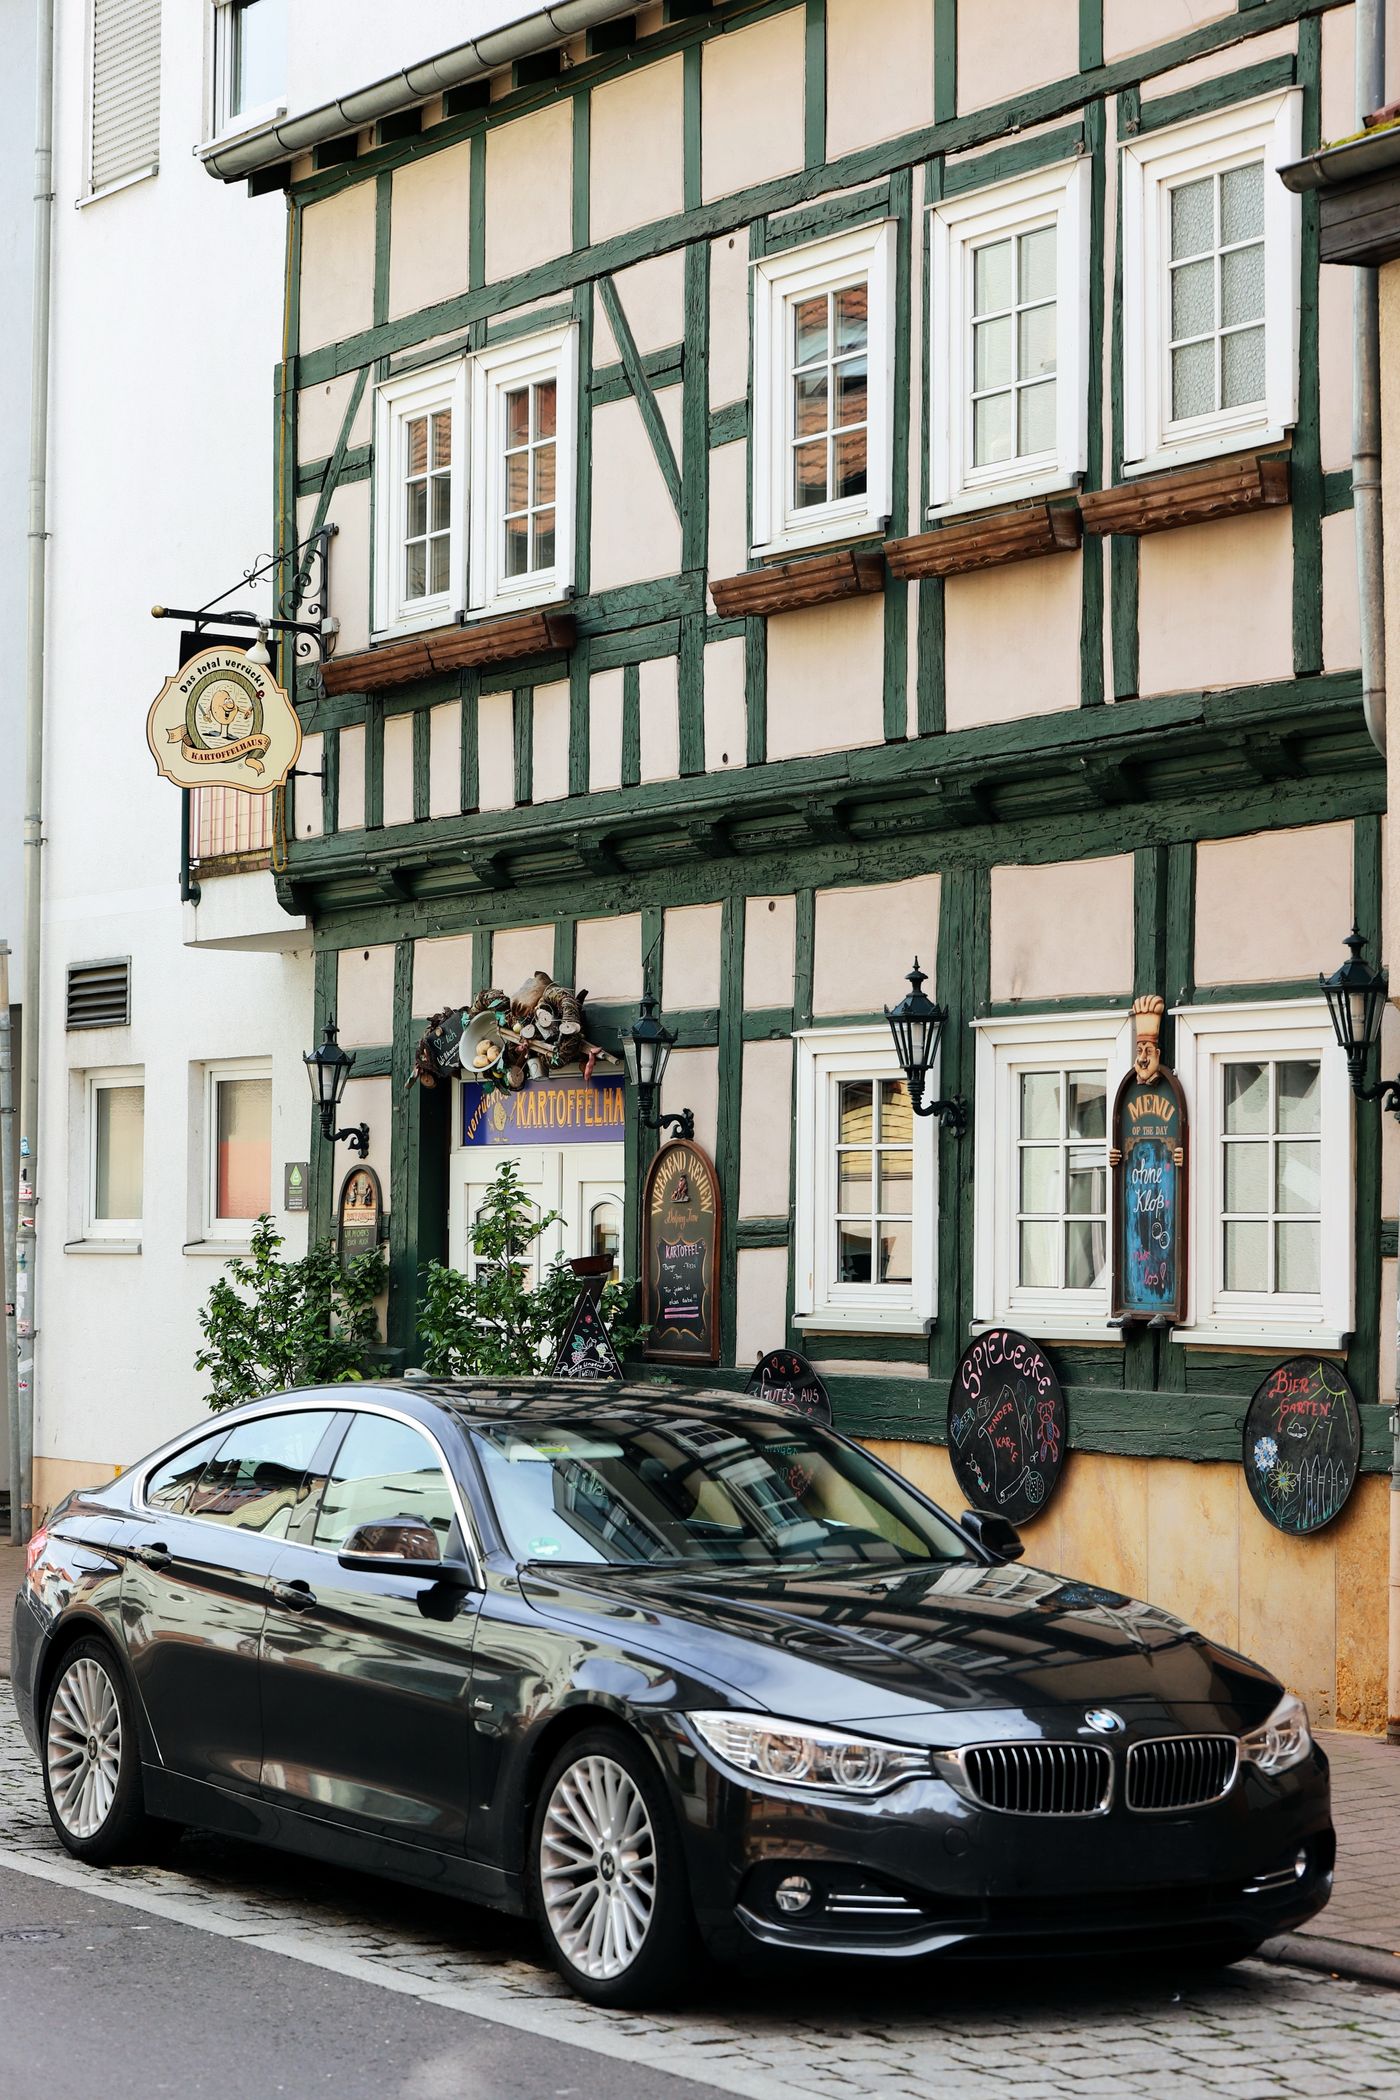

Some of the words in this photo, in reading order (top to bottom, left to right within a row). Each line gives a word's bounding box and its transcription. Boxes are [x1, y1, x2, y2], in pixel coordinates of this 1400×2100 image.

[179, 676, 196, 694] Das
[197, 657, 221, 675] total
[225, 658, 265, 700] verrückte
[191, 738, 264, 761] KARTOFFELHAUS
[1127, 1094, 1175, 1122] MENU
[1131, 1126, 1141, 1136] OF
[1143, 1126, 1154, 1136] THE
[1155, 1125, 1168, 1135] DAY
[651, 1151, 687, 1216] WEEKEND
[688, 1154, 713, 1214] REVIEW
[1131, 1158, 1162, 1185] ohne
[961, 1332, 1051, 1399] SPIELECKE
[801, 1387, 819, 1404] AUS
[987, 1402, 1014, 1435] KINDER
[1277, 1397, 1331, 1433] GARTEN
[995, 1436, 1019, 1463] KARTE
